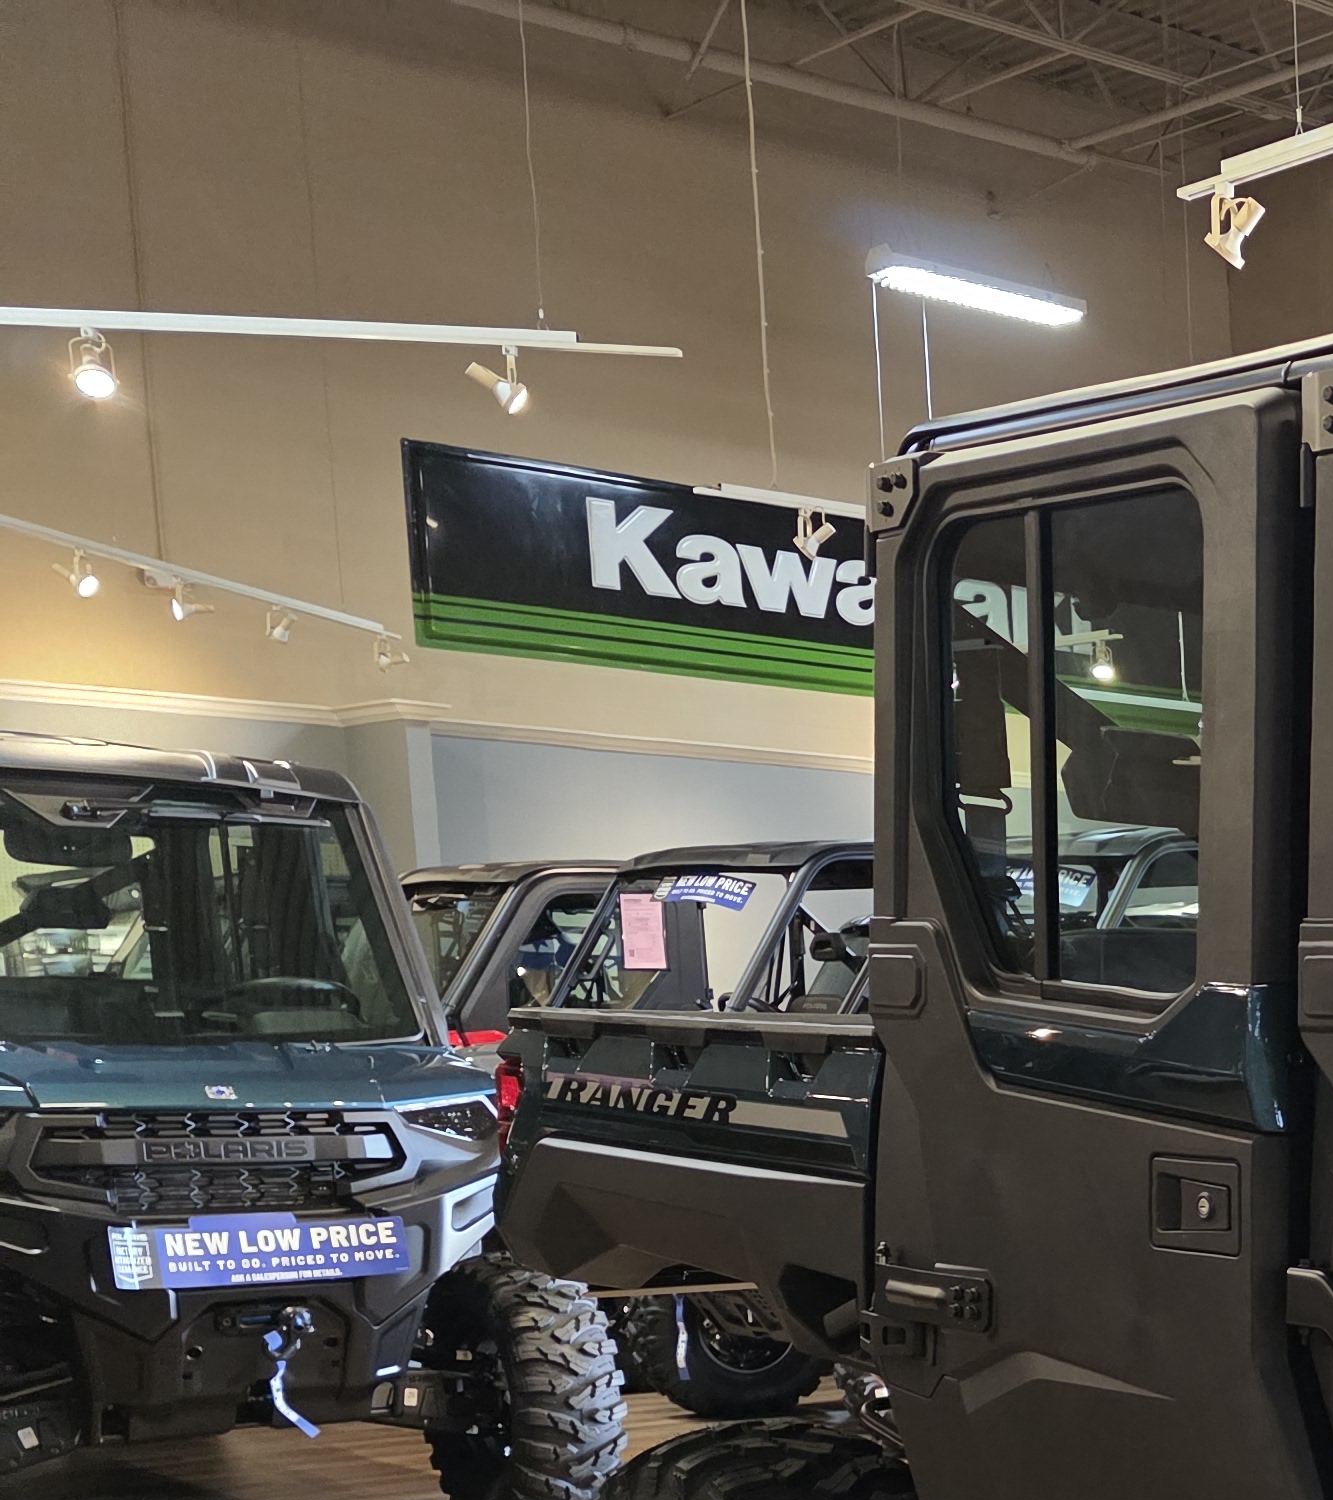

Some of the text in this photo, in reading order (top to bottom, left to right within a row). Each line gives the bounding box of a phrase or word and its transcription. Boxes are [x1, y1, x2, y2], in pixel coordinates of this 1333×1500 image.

[715, 877, 752, 896] PRICE
[556, 1074, 738, 1126] RANGER
[142, 1139, 308, 1162] POLARIS
[164, 1221, 398, 1257] NEW LOW PRICE
[168, 1260, 212, 1274] BUILT
[216, 1259, 237, 1270] TO
[271, 1253, 325, 1268] PRICED
[330, 1252, 350, 1264] TO
[354, 1248, 401, 1261] MOVE.
